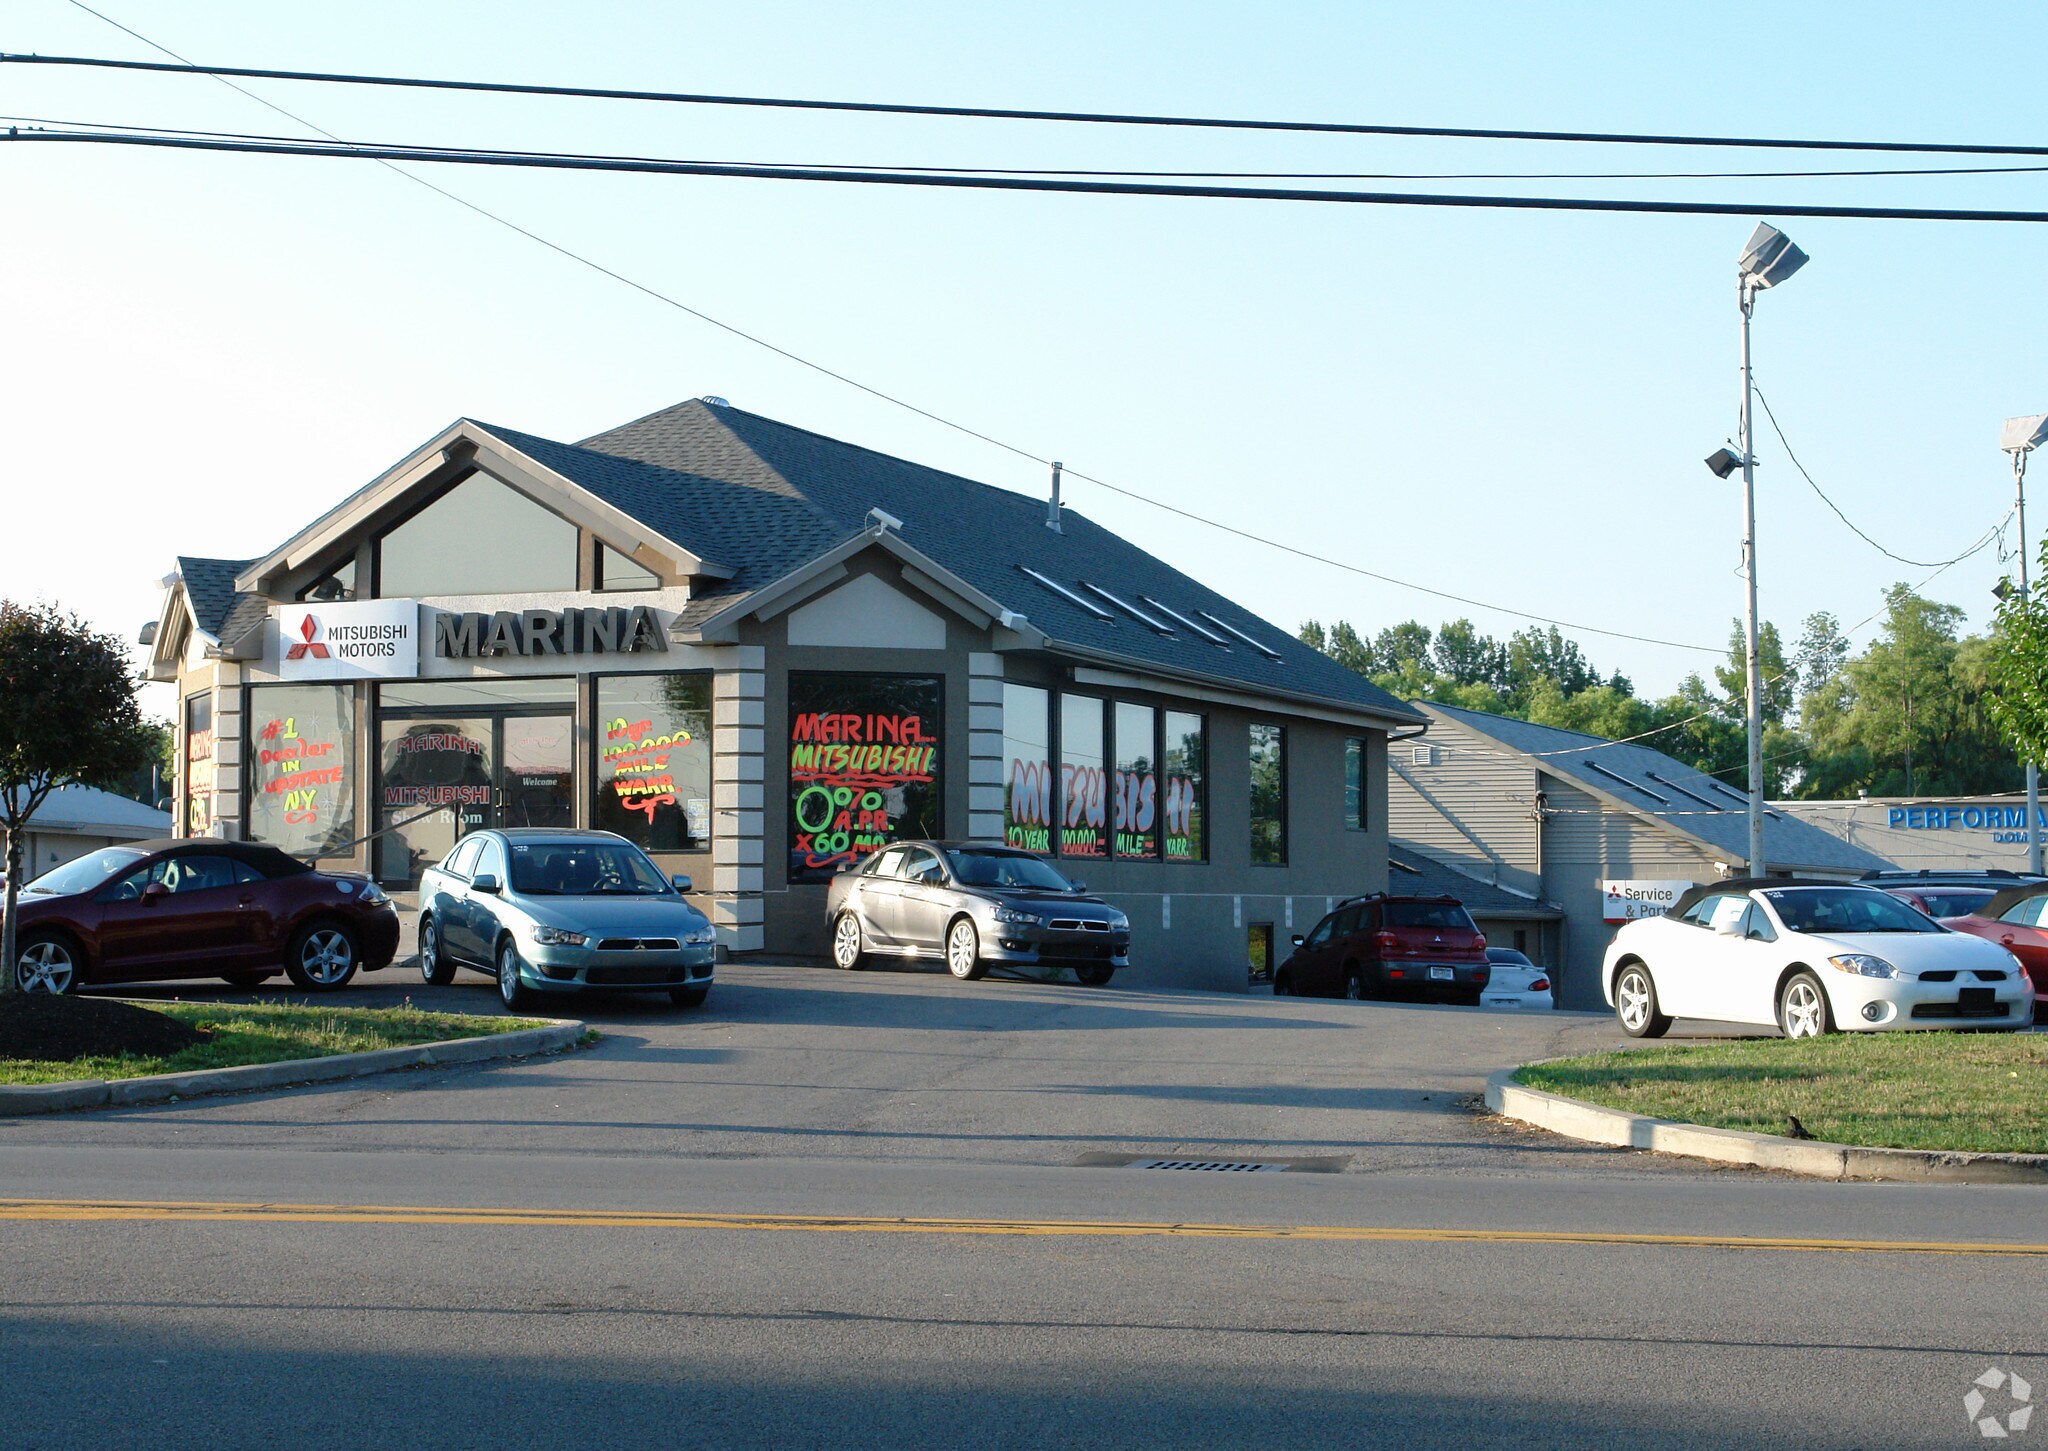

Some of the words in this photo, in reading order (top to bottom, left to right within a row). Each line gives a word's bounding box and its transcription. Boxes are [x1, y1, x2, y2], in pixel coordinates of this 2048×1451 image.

[328, 624, 408, 641] MITSUBISHI
[436, 605, 669, 658] MARINA
[338, 641, 396, 658] MOTORS
[260, 717, 299, 741] #1
[396, 733, 480, 755] MARINA
[281, 760, 301, 773] IN
[615, 754, 671, 776] MILE
[791, 744, 935, 775] MITSUBISHI
[522, 777, 558, 786] Welcome
[613, 774, 683, 797] WARR.
[284, 789, 319, 812] N.Y.
[384, 786, 490, 805] MITSUBISHI
[392, 810, 434, 824] Shw
[1007, 827, 1023, 848] 10
[1025, 829, 1050, 850] YEAR
[1991, 831, 2047, 843] DOMS
[1625, 888, 1673, 901] Service
[1626, 904, 1635, 917] &
[1640, 904, 1674, 917] Part
